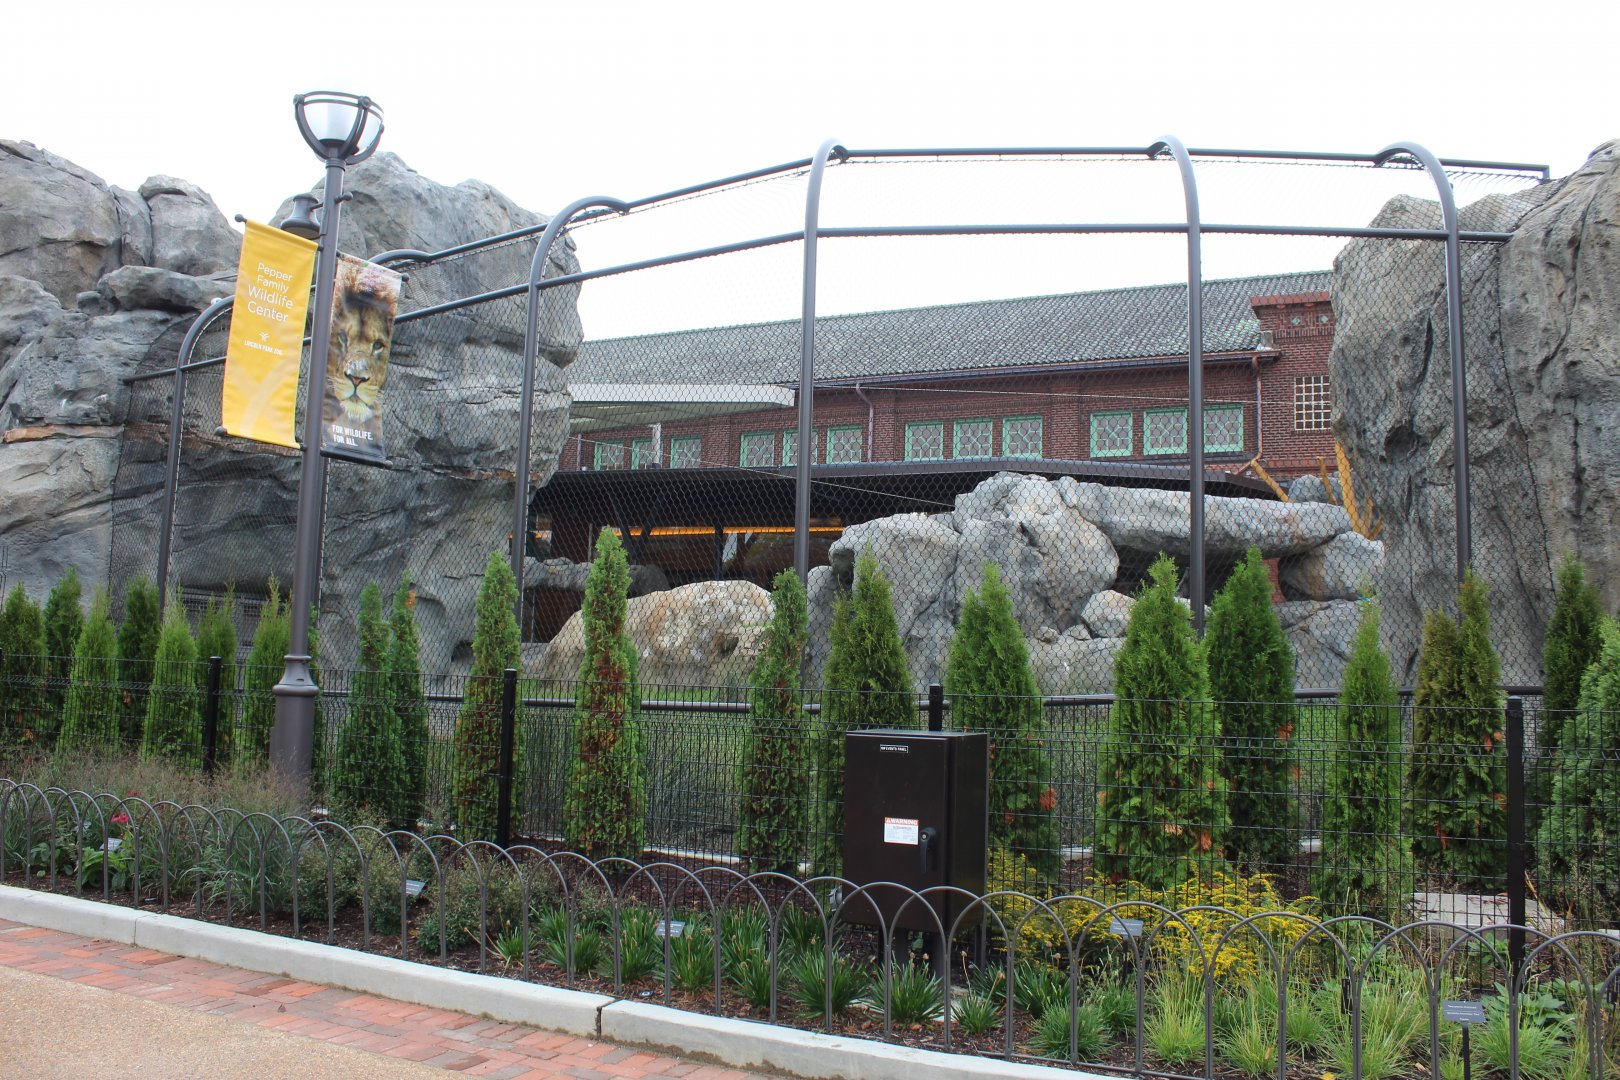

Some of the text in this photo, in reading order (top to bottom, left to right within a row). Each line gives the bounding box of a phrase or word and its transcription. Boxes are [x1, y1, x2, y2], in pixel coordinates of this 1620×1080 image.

[257, 262, 293, 282] Pepper
[256, 274, 290, 293] Family
[248, 285, 294, 309] Wildlife
[247, 301, 289, 322] Center
[244, 340, 262, 350] LINCOLN
[262, 344, 273, 353] PARK
[332, 424, 343, 434] FOR
[333, 434, 344, 443] FOR
